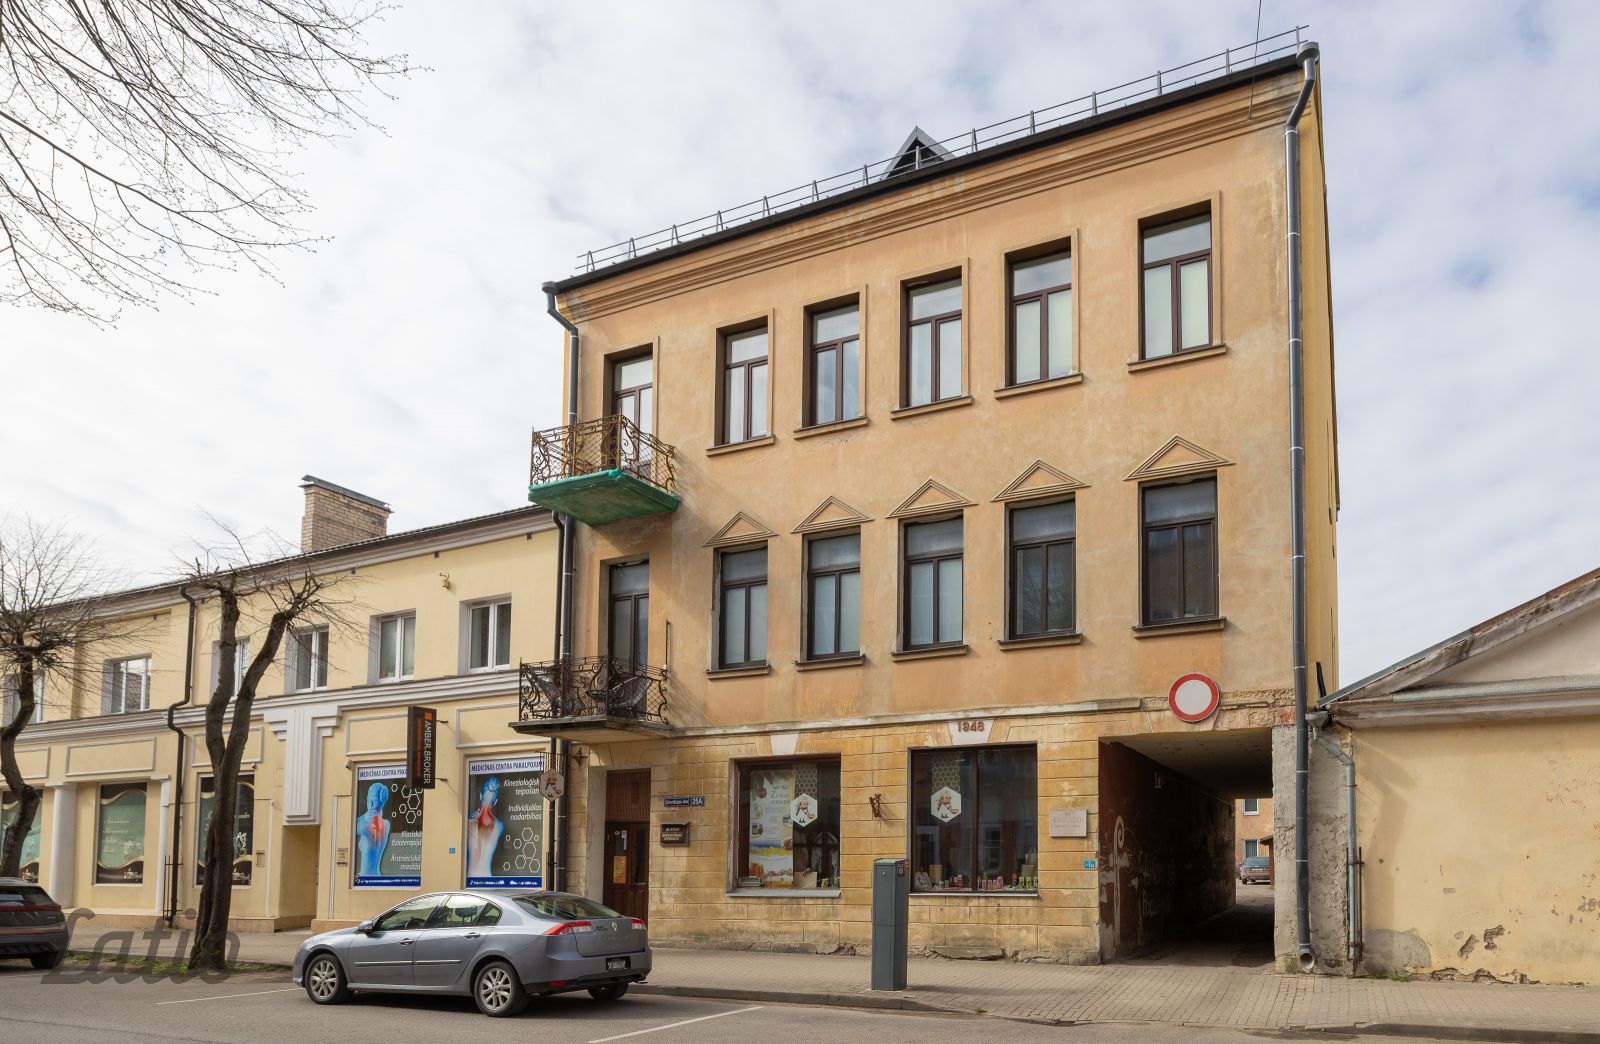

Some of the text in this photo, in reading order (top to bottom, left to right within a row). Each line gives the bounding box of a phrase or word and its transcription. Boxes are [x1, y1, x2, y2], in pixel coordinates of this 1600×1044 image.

[957, 720, 985, 732] 1948
[495, 763, 513, 771] CENTRA
[503, 778, 540, 788] Kinezioloģisk
[515, 787, 540, 797] teipošan
